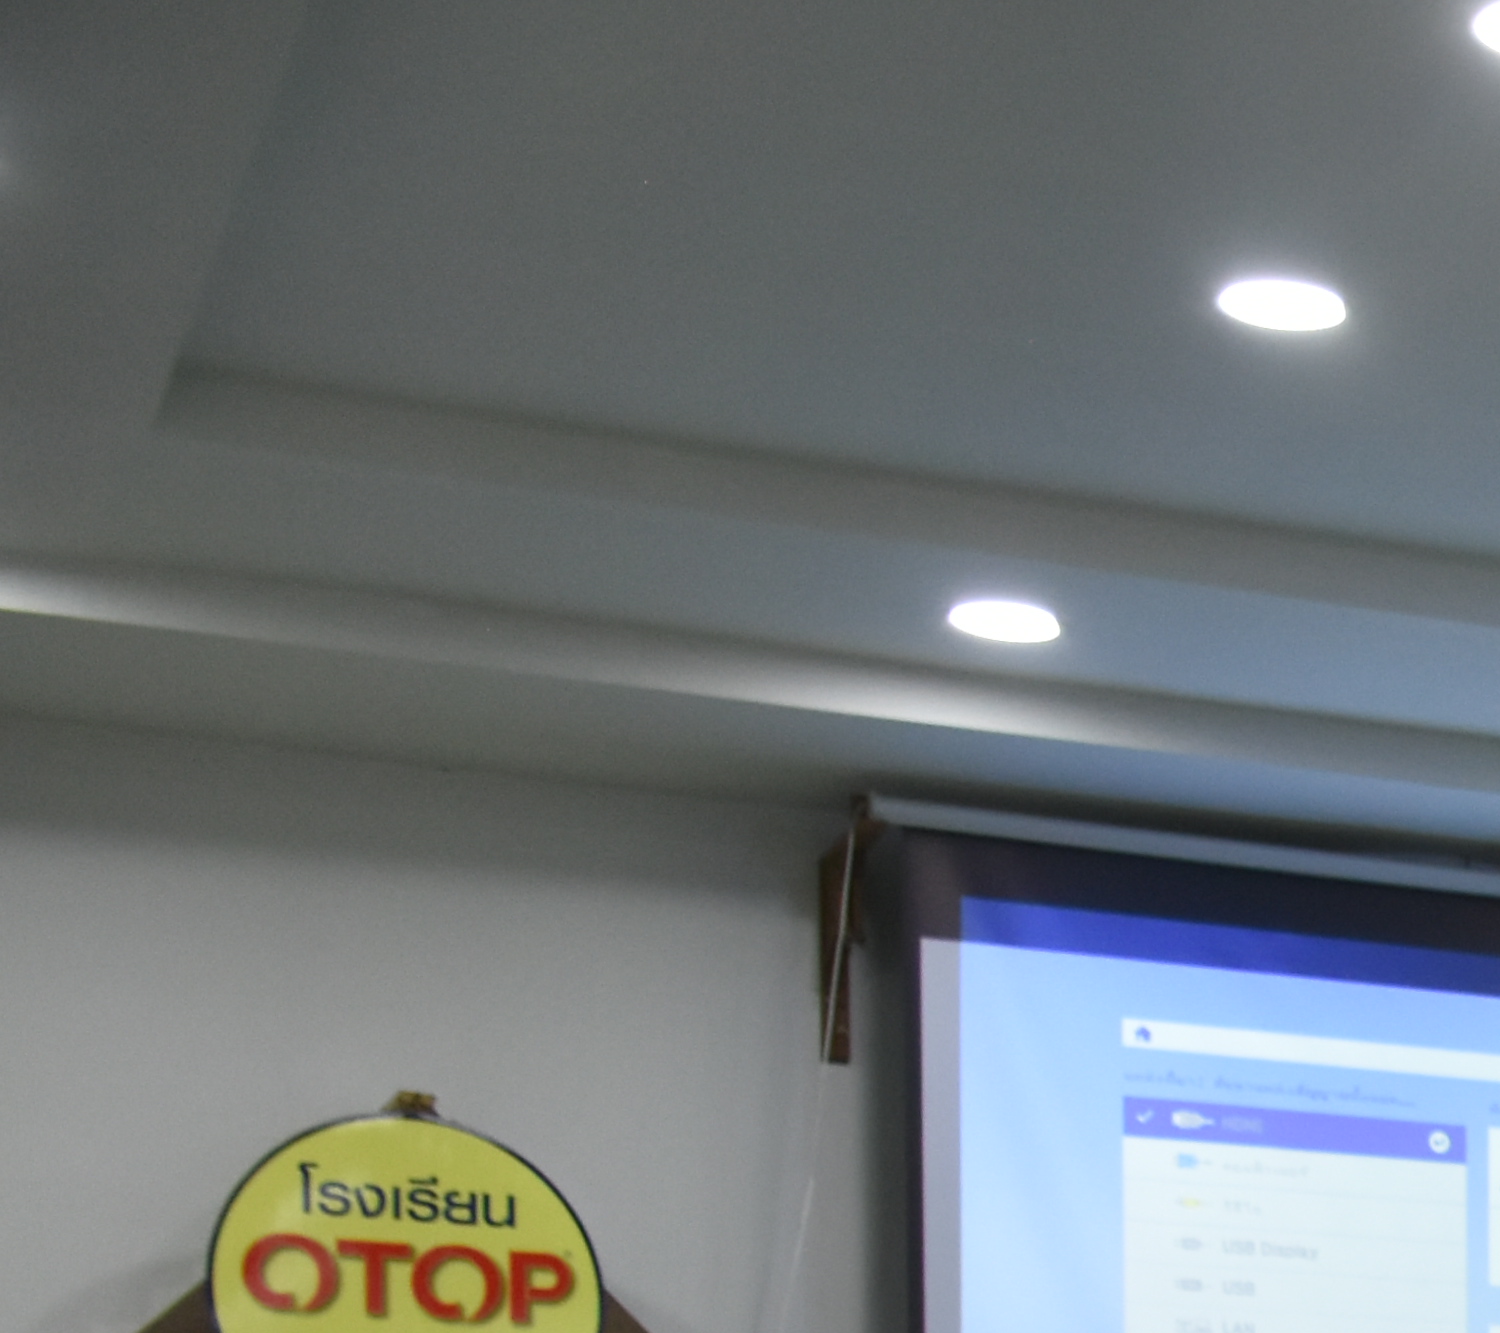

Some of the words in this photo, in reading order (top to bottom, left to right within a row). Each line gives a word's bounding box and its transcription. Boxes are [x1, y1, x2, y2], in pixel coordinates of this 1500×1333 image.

[299, 1162, 518, 1229] โรงเรียน
[241, 1232, 576, 1326] OTOP
[1222, 1280, 1255, 1297] USB
